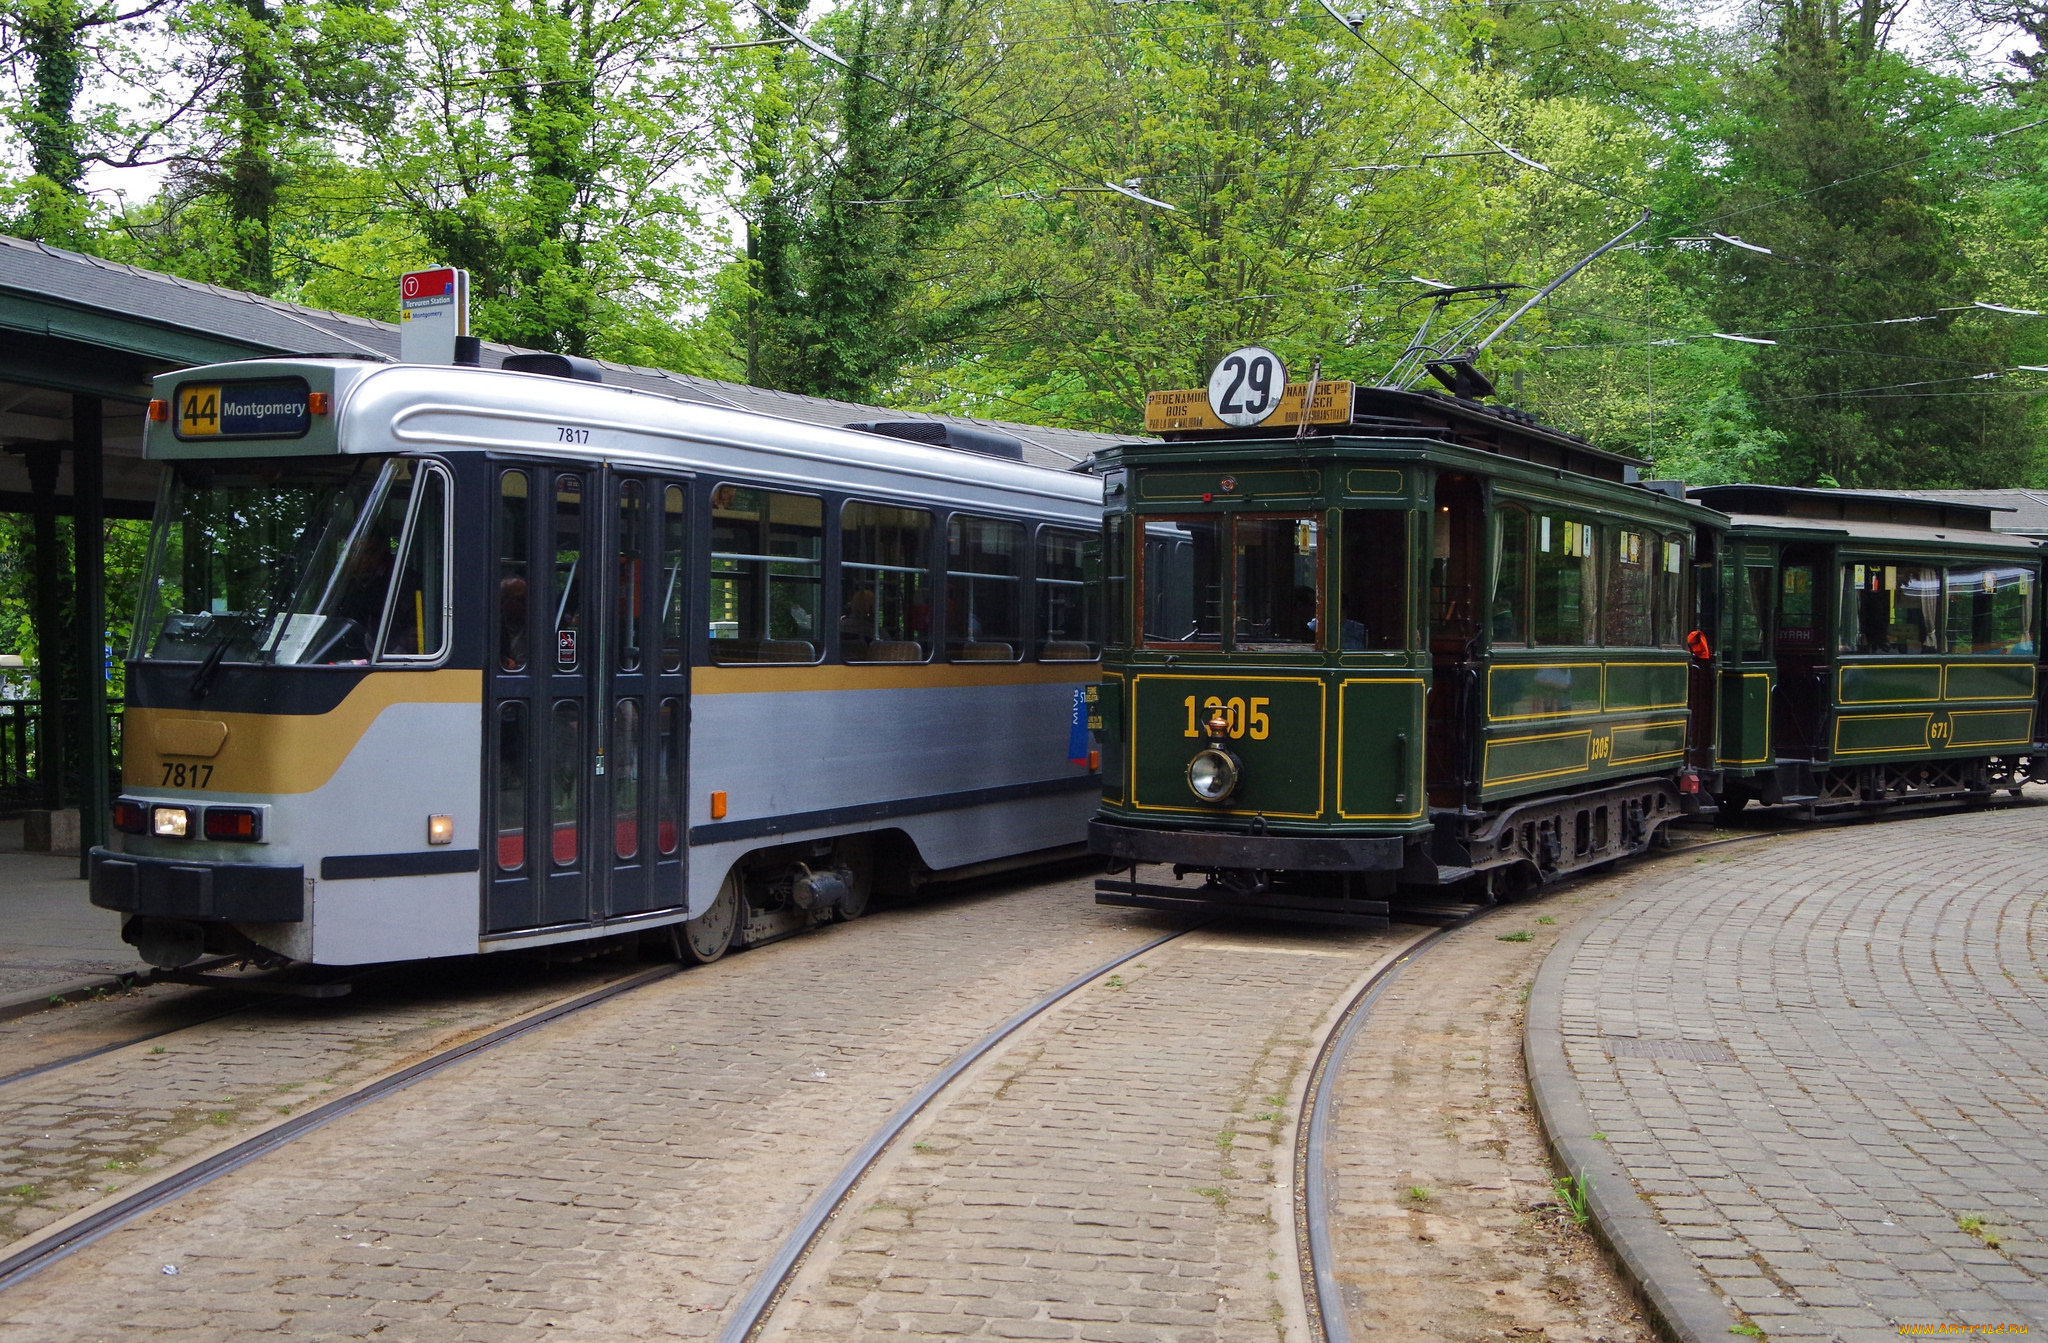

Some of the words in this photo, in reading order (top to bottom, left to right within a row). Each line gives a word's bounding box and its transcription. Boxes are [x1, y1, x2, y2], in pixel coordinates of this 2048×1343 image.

[406, 300, 430, 308] Tervuren
[430, 297, 451, 305] Station
[402, 312, 411, 320] 44
[412, 311, 443, 319] Montgomery
[1219, 355, 1273, 415] 29
[183, 394, 218, 427] 44
[223, 402, 306, 419] Montgomery
[1166, 405, 1188, 417] BOIS
[557, 427, 589, 445] 7817
[1184, 695, 1270, 740] 1305
[1931, 722, 1948, 739] 671
[1591, 736, 1610, 760] 1305
[162, 763, 214, 788] 7817
